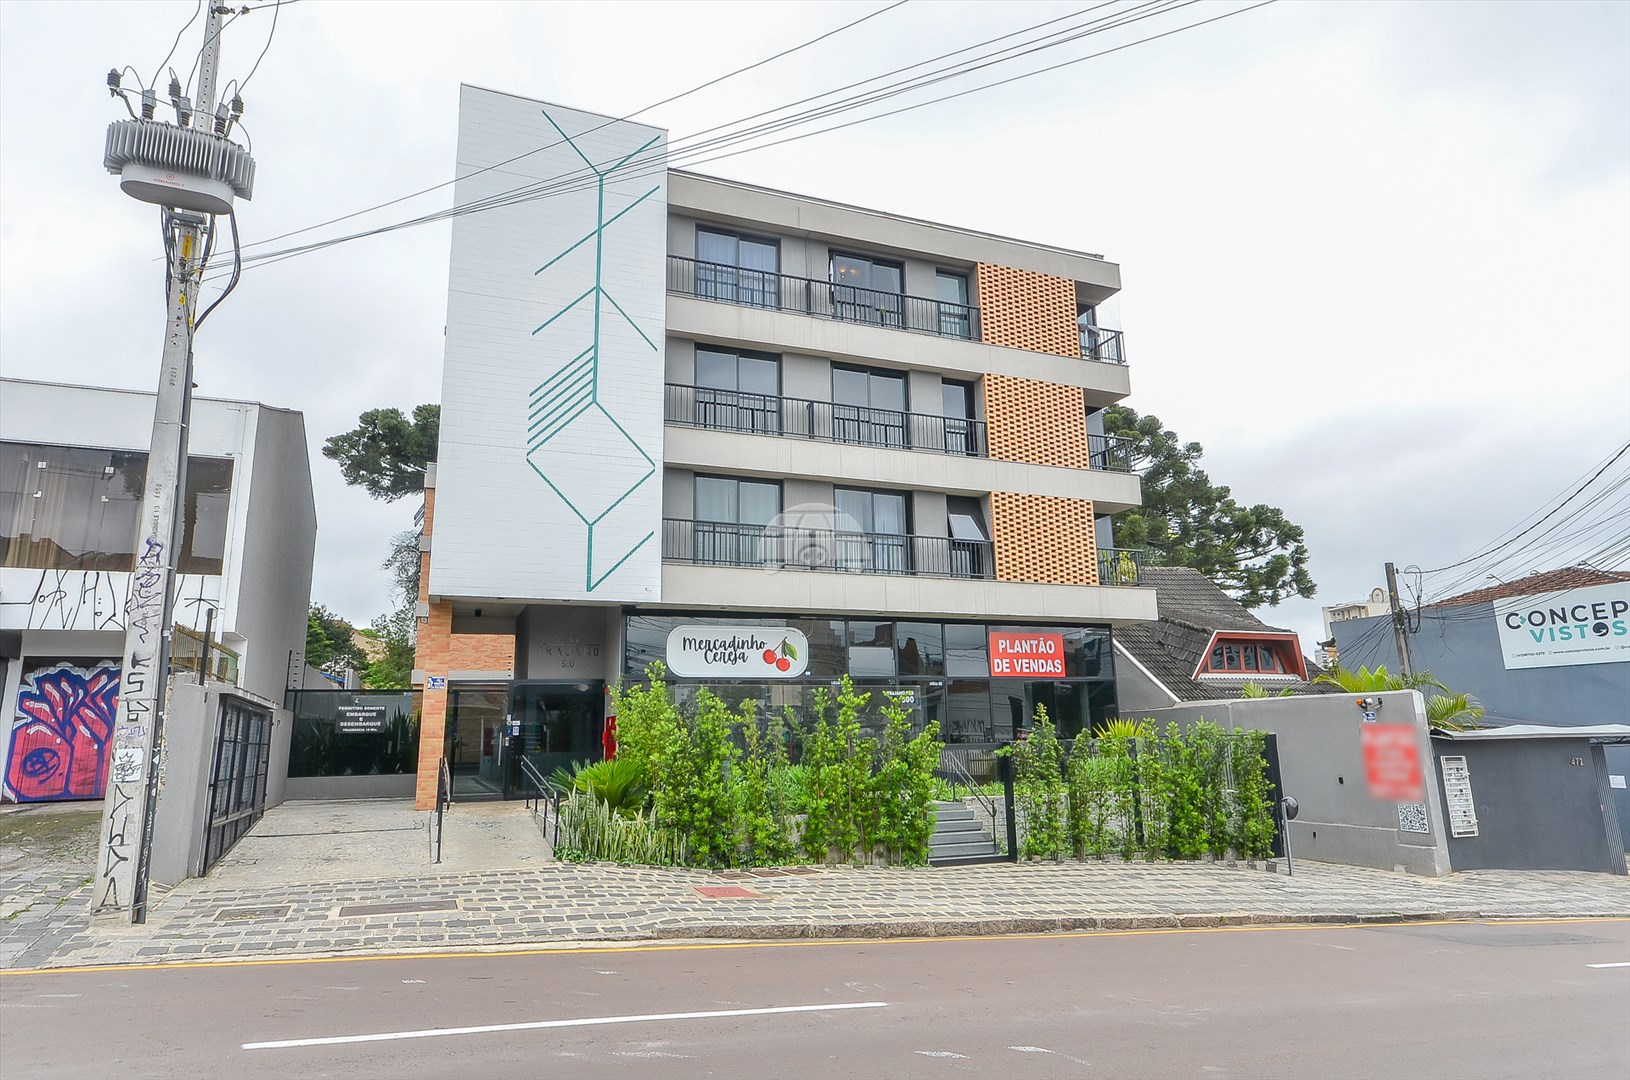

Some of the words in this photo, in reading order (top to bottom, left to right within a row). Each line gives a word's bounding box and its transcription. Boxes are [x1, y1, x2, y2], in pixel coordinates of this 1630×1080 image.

[1529, 620, 1628, 643] VISTOS
[682, 634, 767, 652] Mercadinho
[998, 637, 1055, 654] PLANTÃO
[704, 649, 749, 665] Cereja
[993, 658, 1011, 673] DE
[1013, 658, 1062, 673] VENDAS
[1570, 757, 1584, 766] 472
